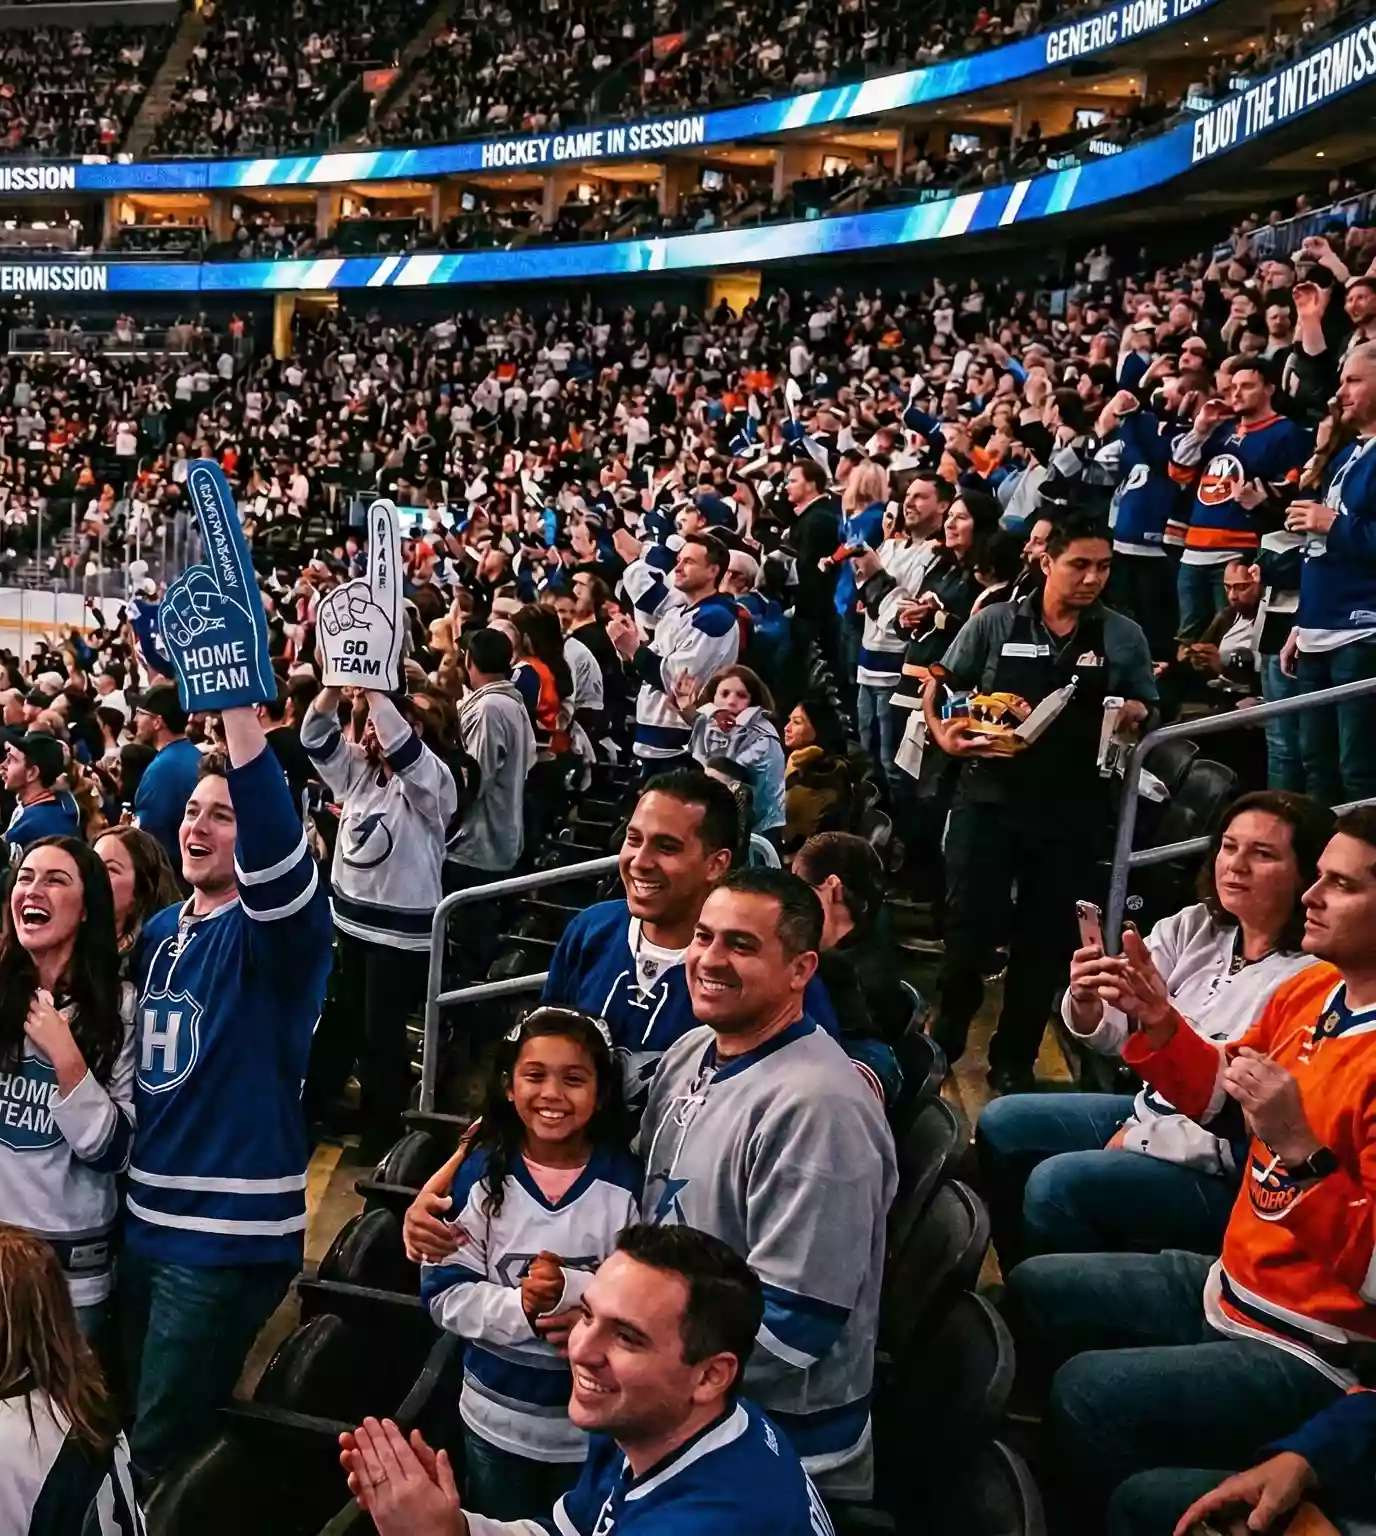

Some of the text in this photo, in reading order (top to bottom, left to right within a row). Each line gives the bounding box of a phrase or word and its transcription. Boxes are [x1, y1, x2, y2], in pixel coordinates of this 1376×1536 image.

[1046, 0, 1168, 64] GENERIC HOME
[1191, 20, 1376, 163] ENJOY THE INTERMISS
[482, 116, 704, 168] HOCKEY GAME IN SESSION
[183, 640, 248, 671] HOME
[332, 657, 381, 676] TEAM
[343, 639, 368, 655] GO
[188, 666, 250, 696] TEAM
[140, 1008, 183, 1074] H
